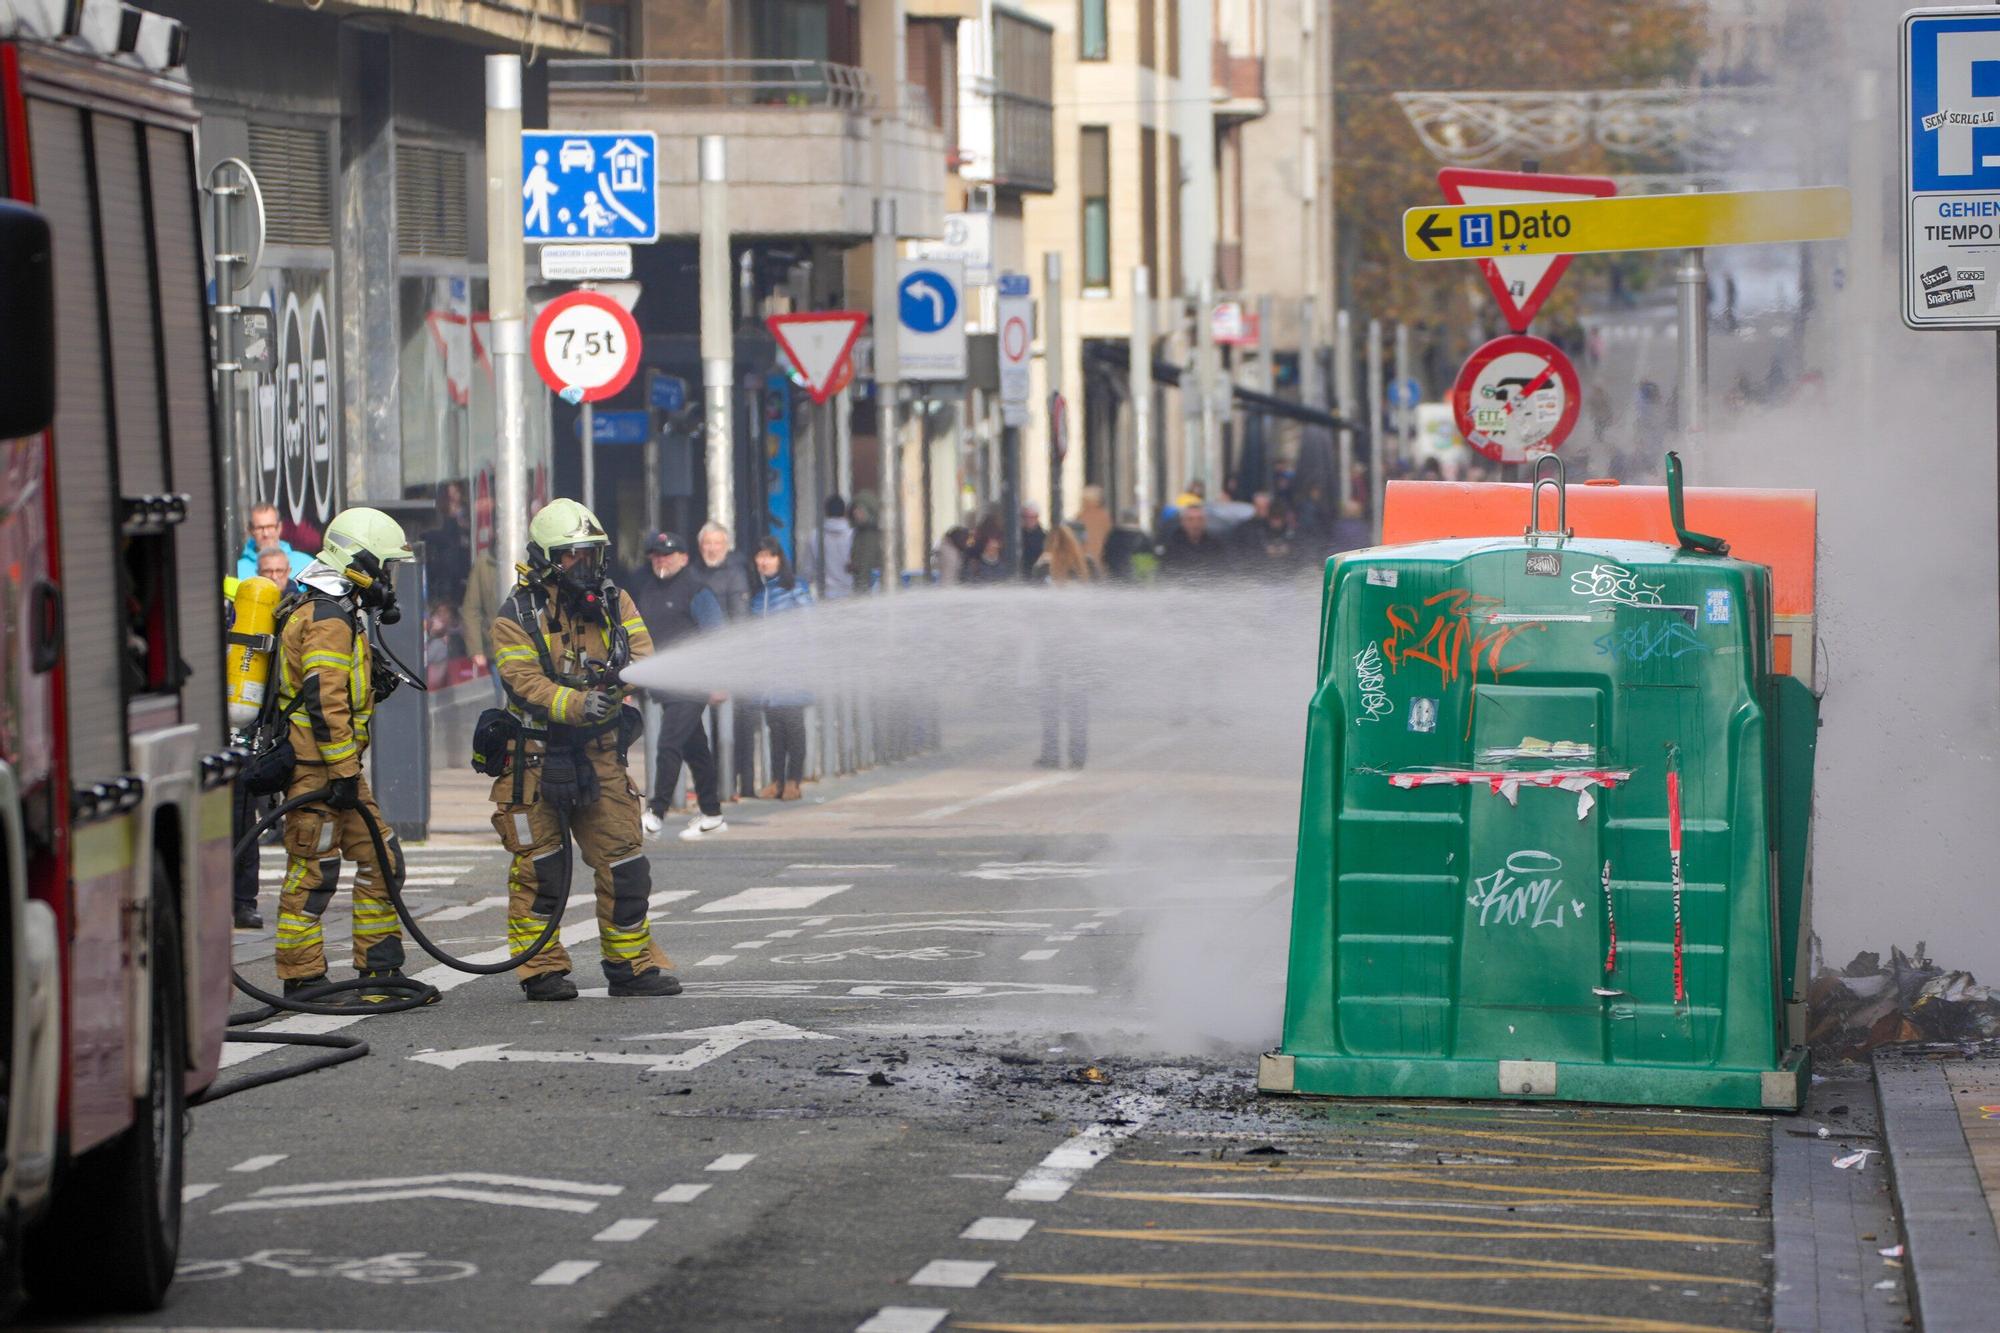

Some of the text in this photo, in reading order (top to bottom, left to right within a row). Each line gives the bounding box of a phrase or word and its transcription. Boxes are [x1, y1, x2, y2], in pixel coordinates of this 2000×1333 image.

[1499, 209, 1571, 240] Dato
[1924, 224, 1993, 241] TIEMPO
[1927, 289, 1973, 305] Snare films
[555, 329, 616, 365] 7,5t
